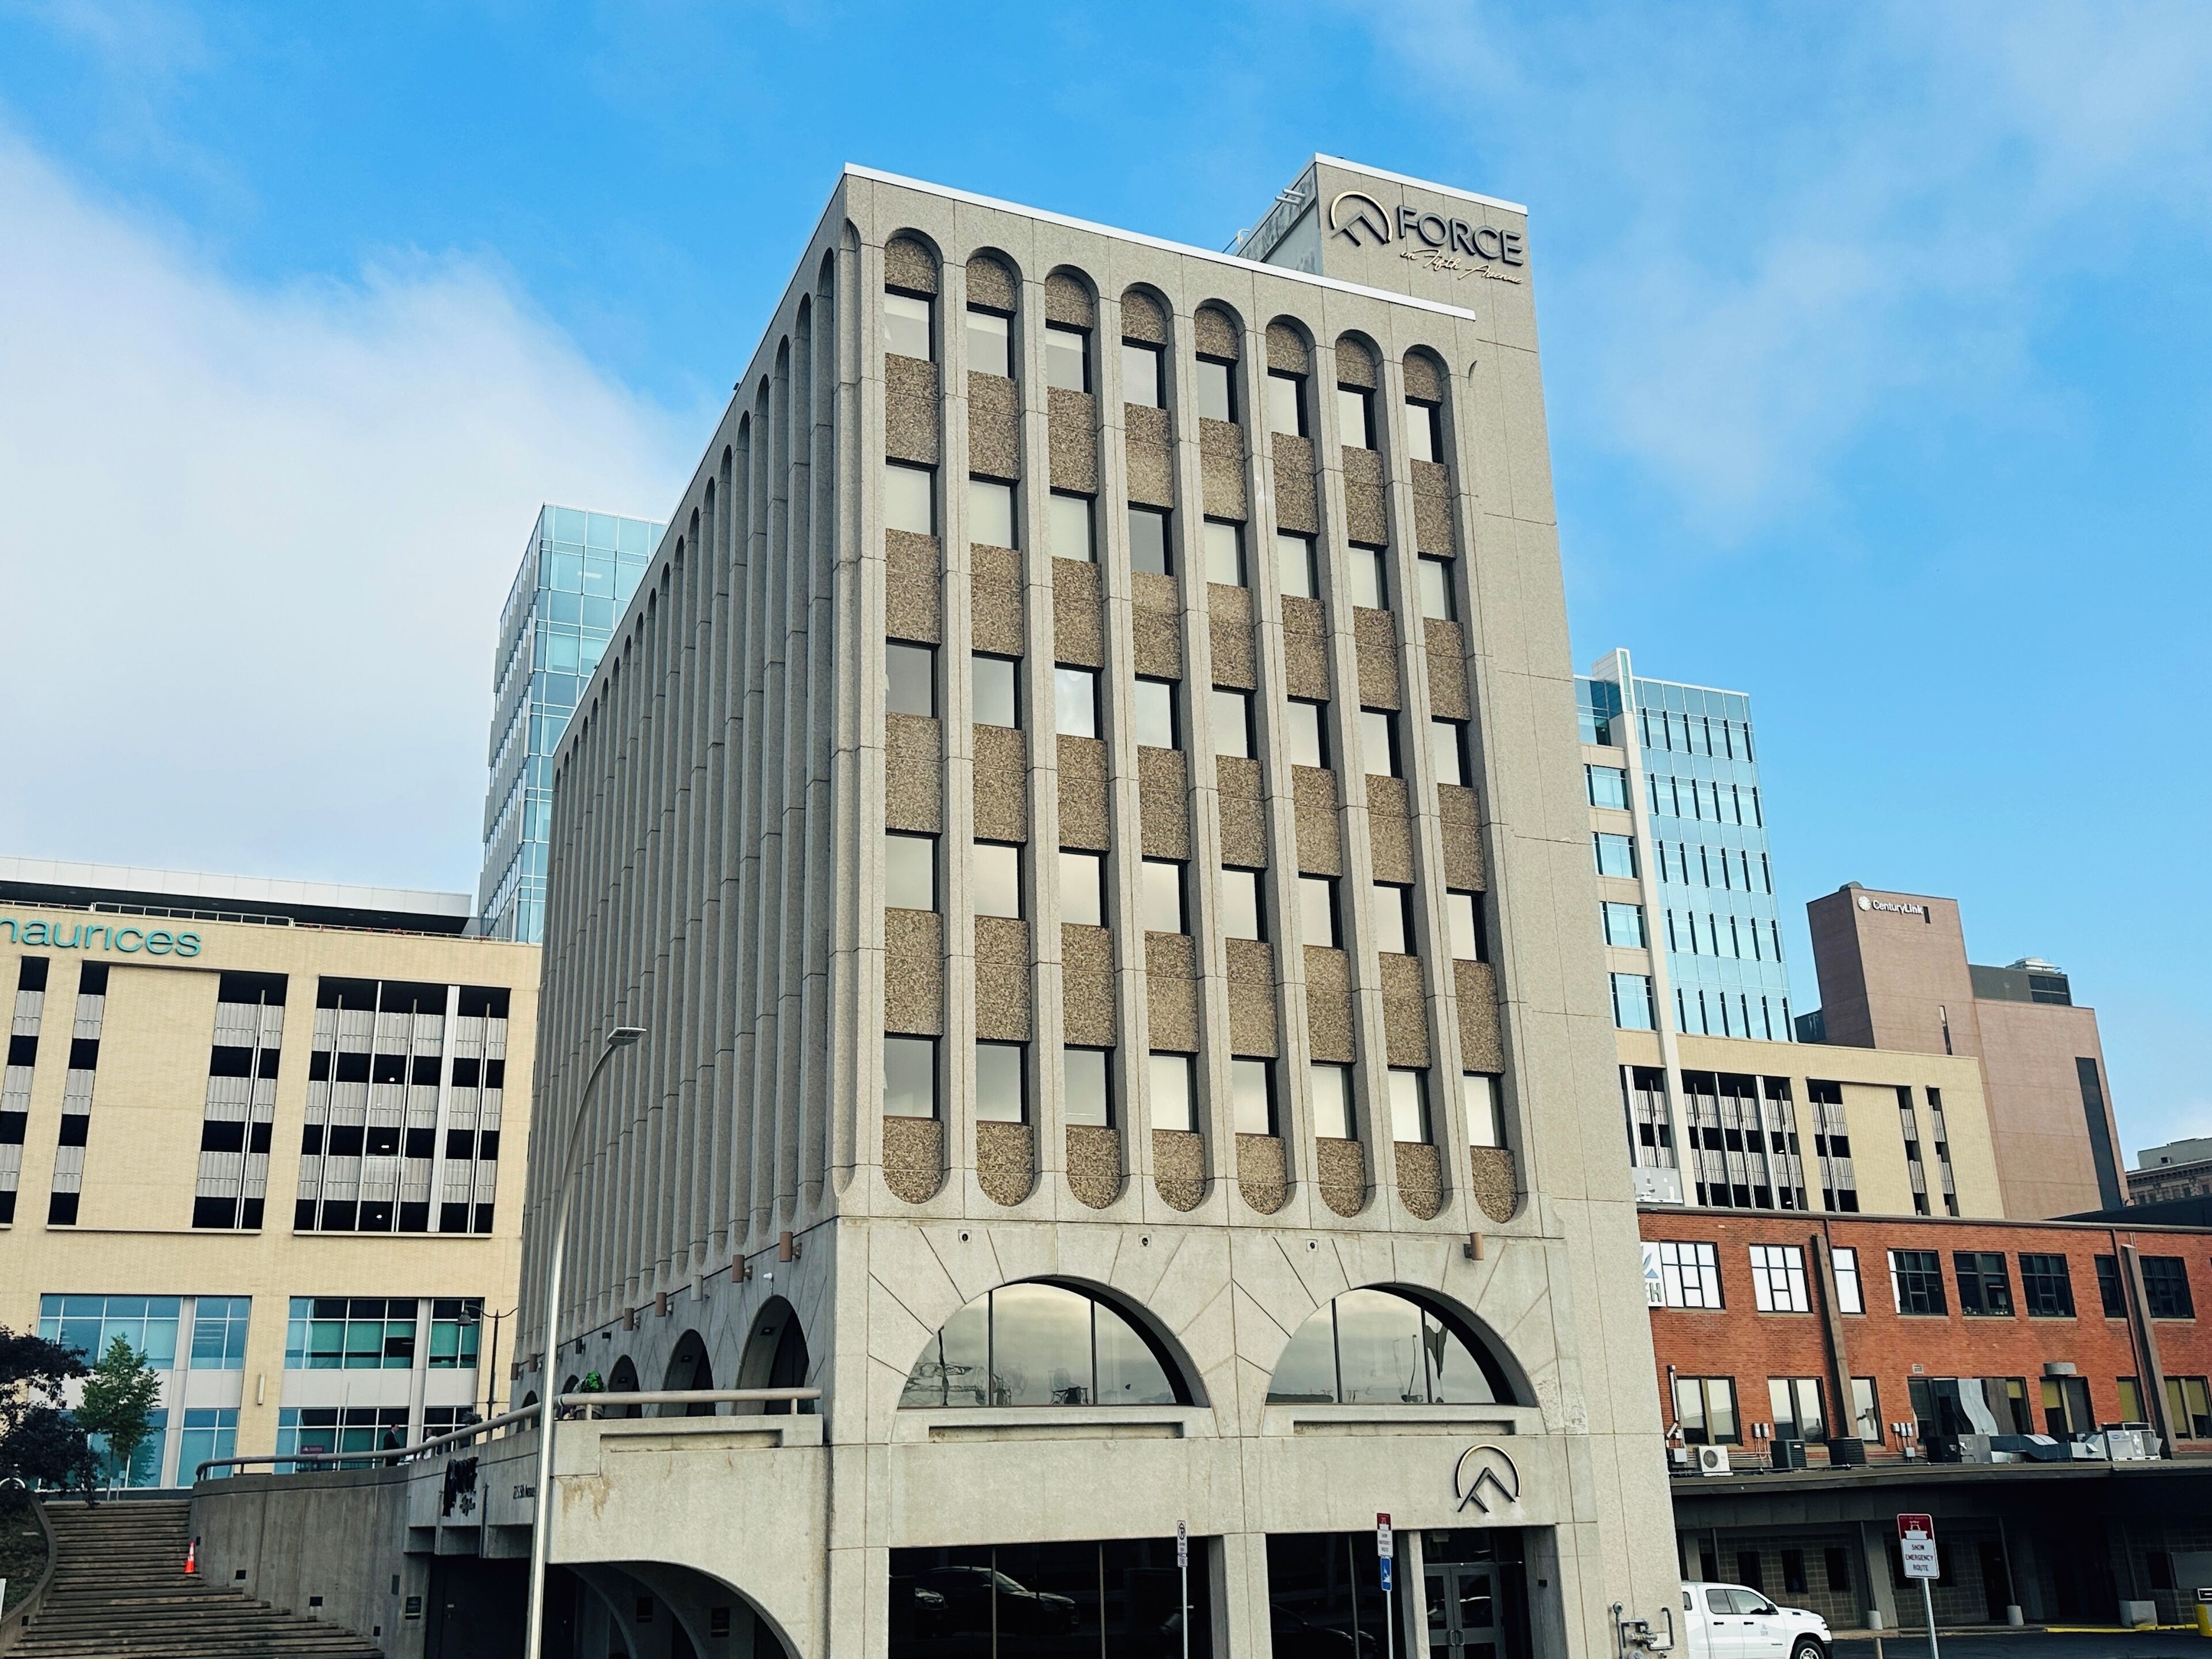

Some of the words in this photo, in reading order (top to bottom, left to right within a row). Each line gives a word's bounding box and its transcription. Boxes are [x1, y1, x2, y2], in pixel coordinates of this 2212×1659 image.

[1397, 205, 1524, 267] FORCE
[1400, 251, 1418, 260] on
[1413, 248, 1461, 271] Fifth
[1458, 264, 1524, 284] Avenue
[1872, 900, 1923, 914] CenturyLink
